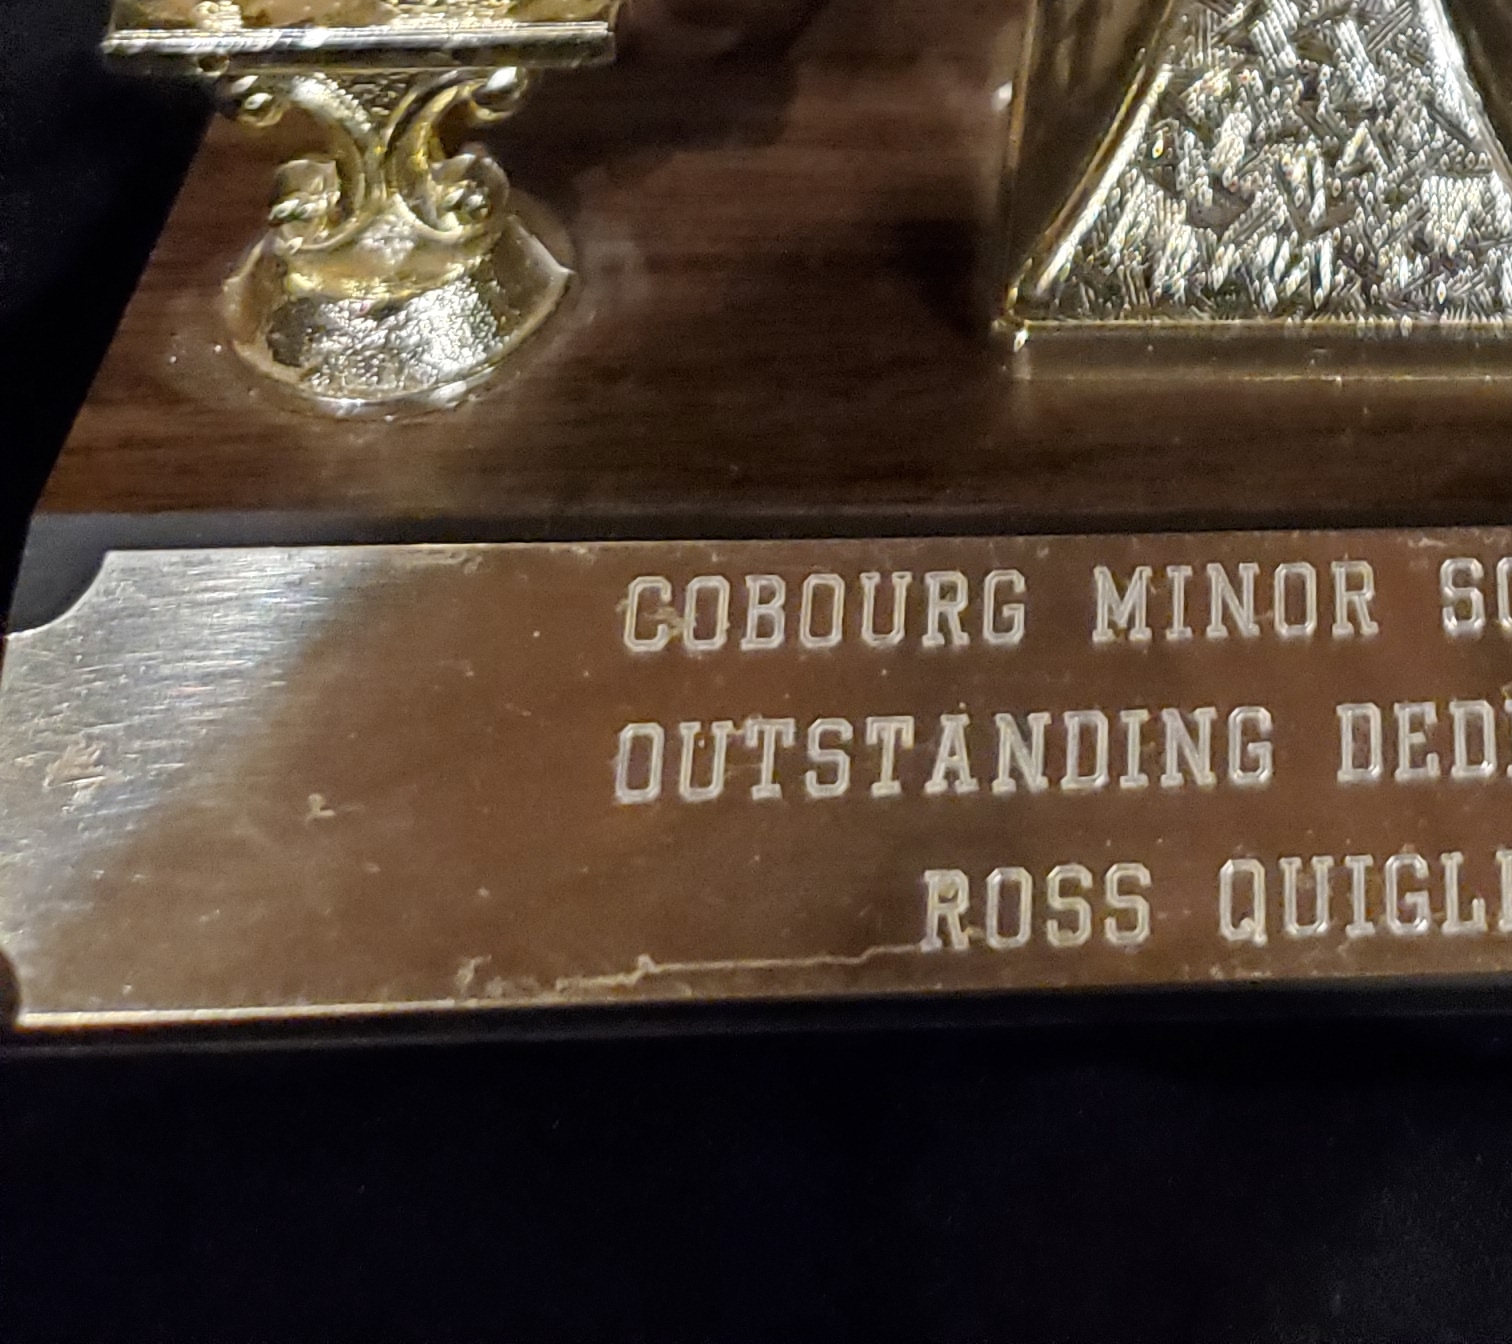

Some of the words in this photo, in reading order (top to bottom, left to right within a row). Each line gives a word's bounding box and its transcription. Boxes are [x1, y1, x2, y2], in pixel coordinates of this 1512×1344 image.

[620, 568, 1029, 655] COBOURG
[1090, 558, 1381, 644] MINOR
[614, 705, 1276, 805] OUTSTANDING
[917, 861, 1154, 954] ROSS
